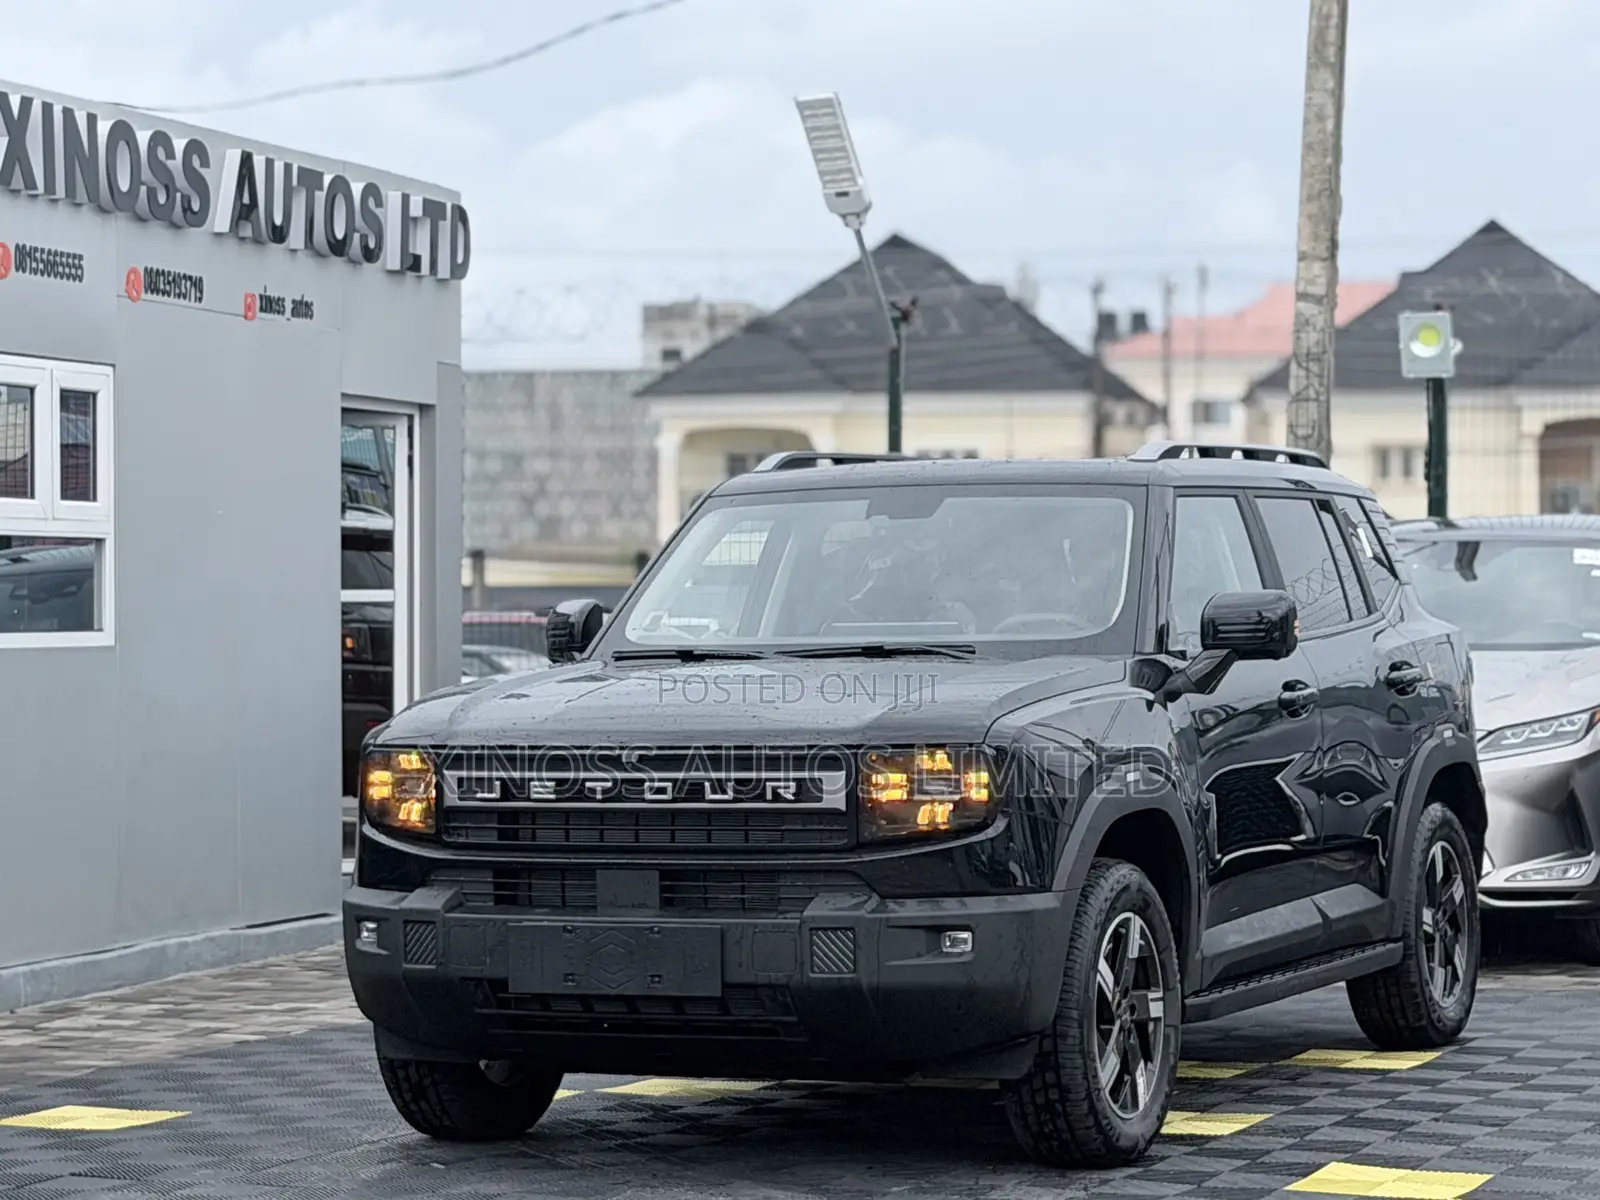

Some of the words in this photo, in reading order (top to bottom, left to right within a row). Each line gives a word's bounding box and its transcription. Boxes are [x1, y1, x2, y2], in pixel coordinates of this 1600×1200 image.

[0, 91, 211, 228] XINOSS
[218, 149, 385, 264] AUTOS
[394, 190, 471, 280] LTD
[14, 242, 84, 284] 08155665555
[475, 780, 797, 801] JETOUR
